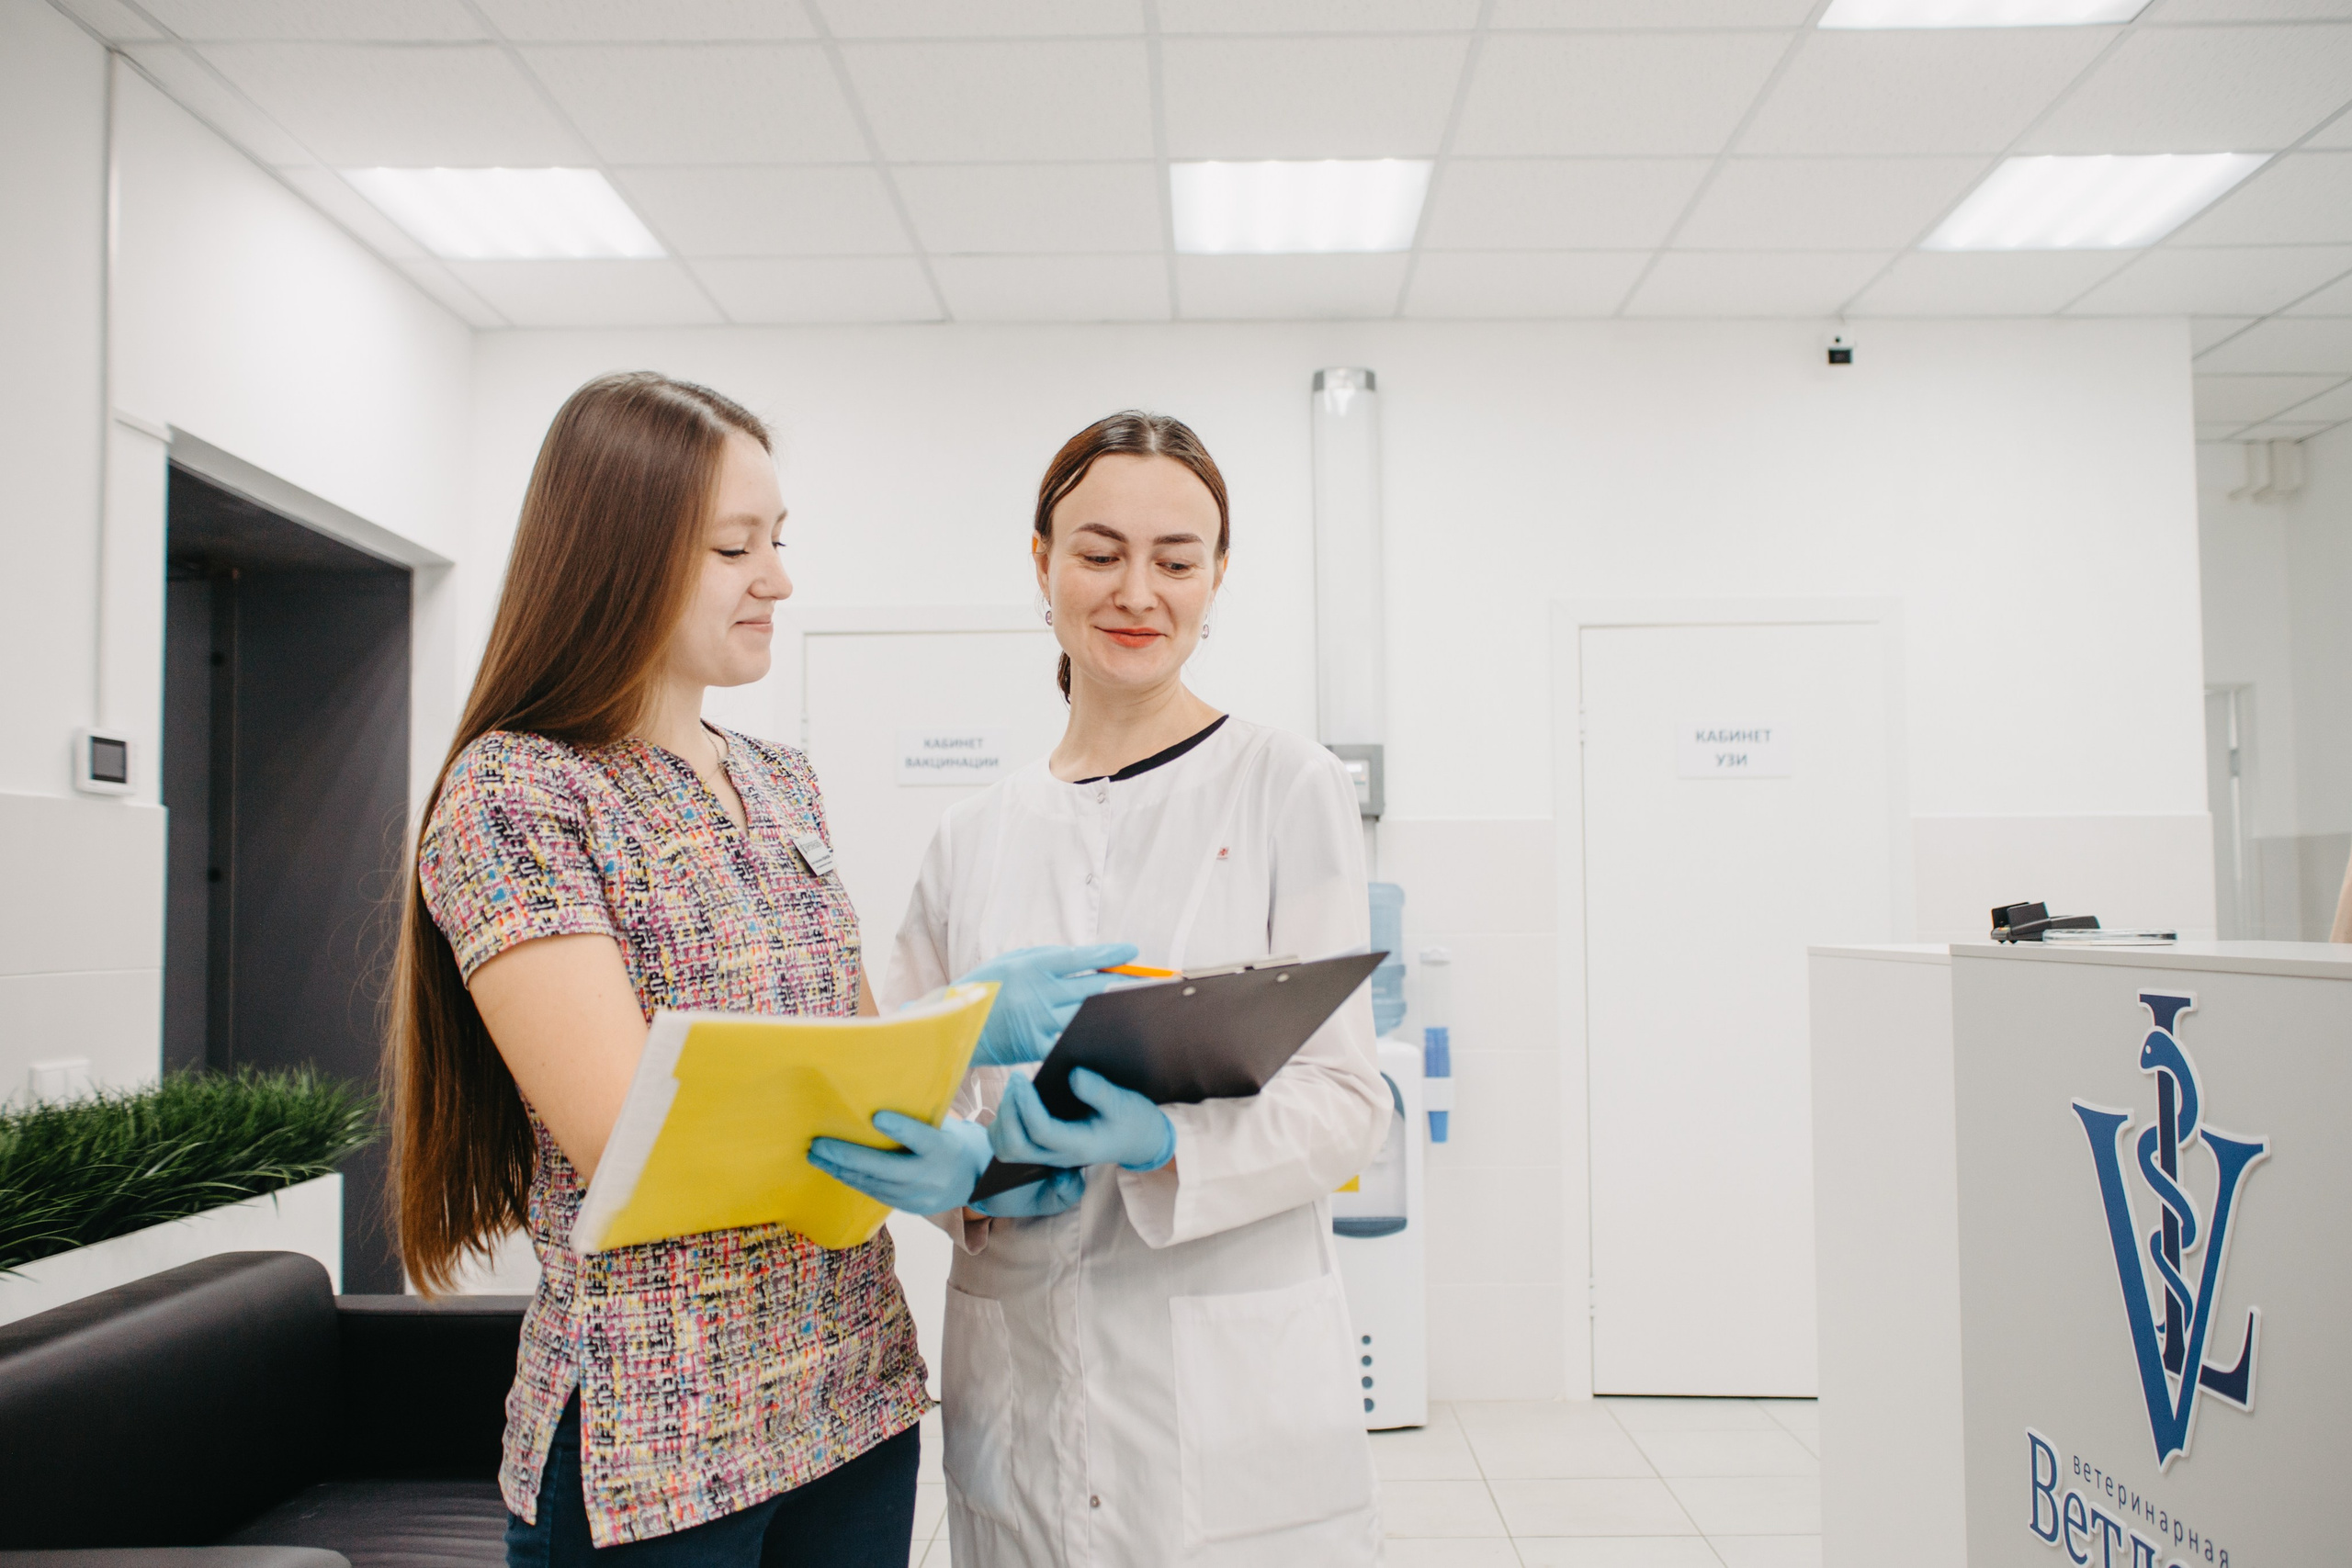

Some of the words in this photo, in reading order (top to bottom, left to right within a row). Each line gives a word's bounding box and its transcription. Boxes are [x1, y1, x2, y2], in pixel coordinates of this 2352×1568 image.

[1696, 729, 1772, 742] КАБИНЕТ
[923, 738, 983, 749] КАБИНЕТ
[905, 758, 999, 770] ВАКЦИНАЦИИ
[1716, 753, 1747, 767] УЗИ
[2073, 1455, 2229, 1568] ветеринарная
